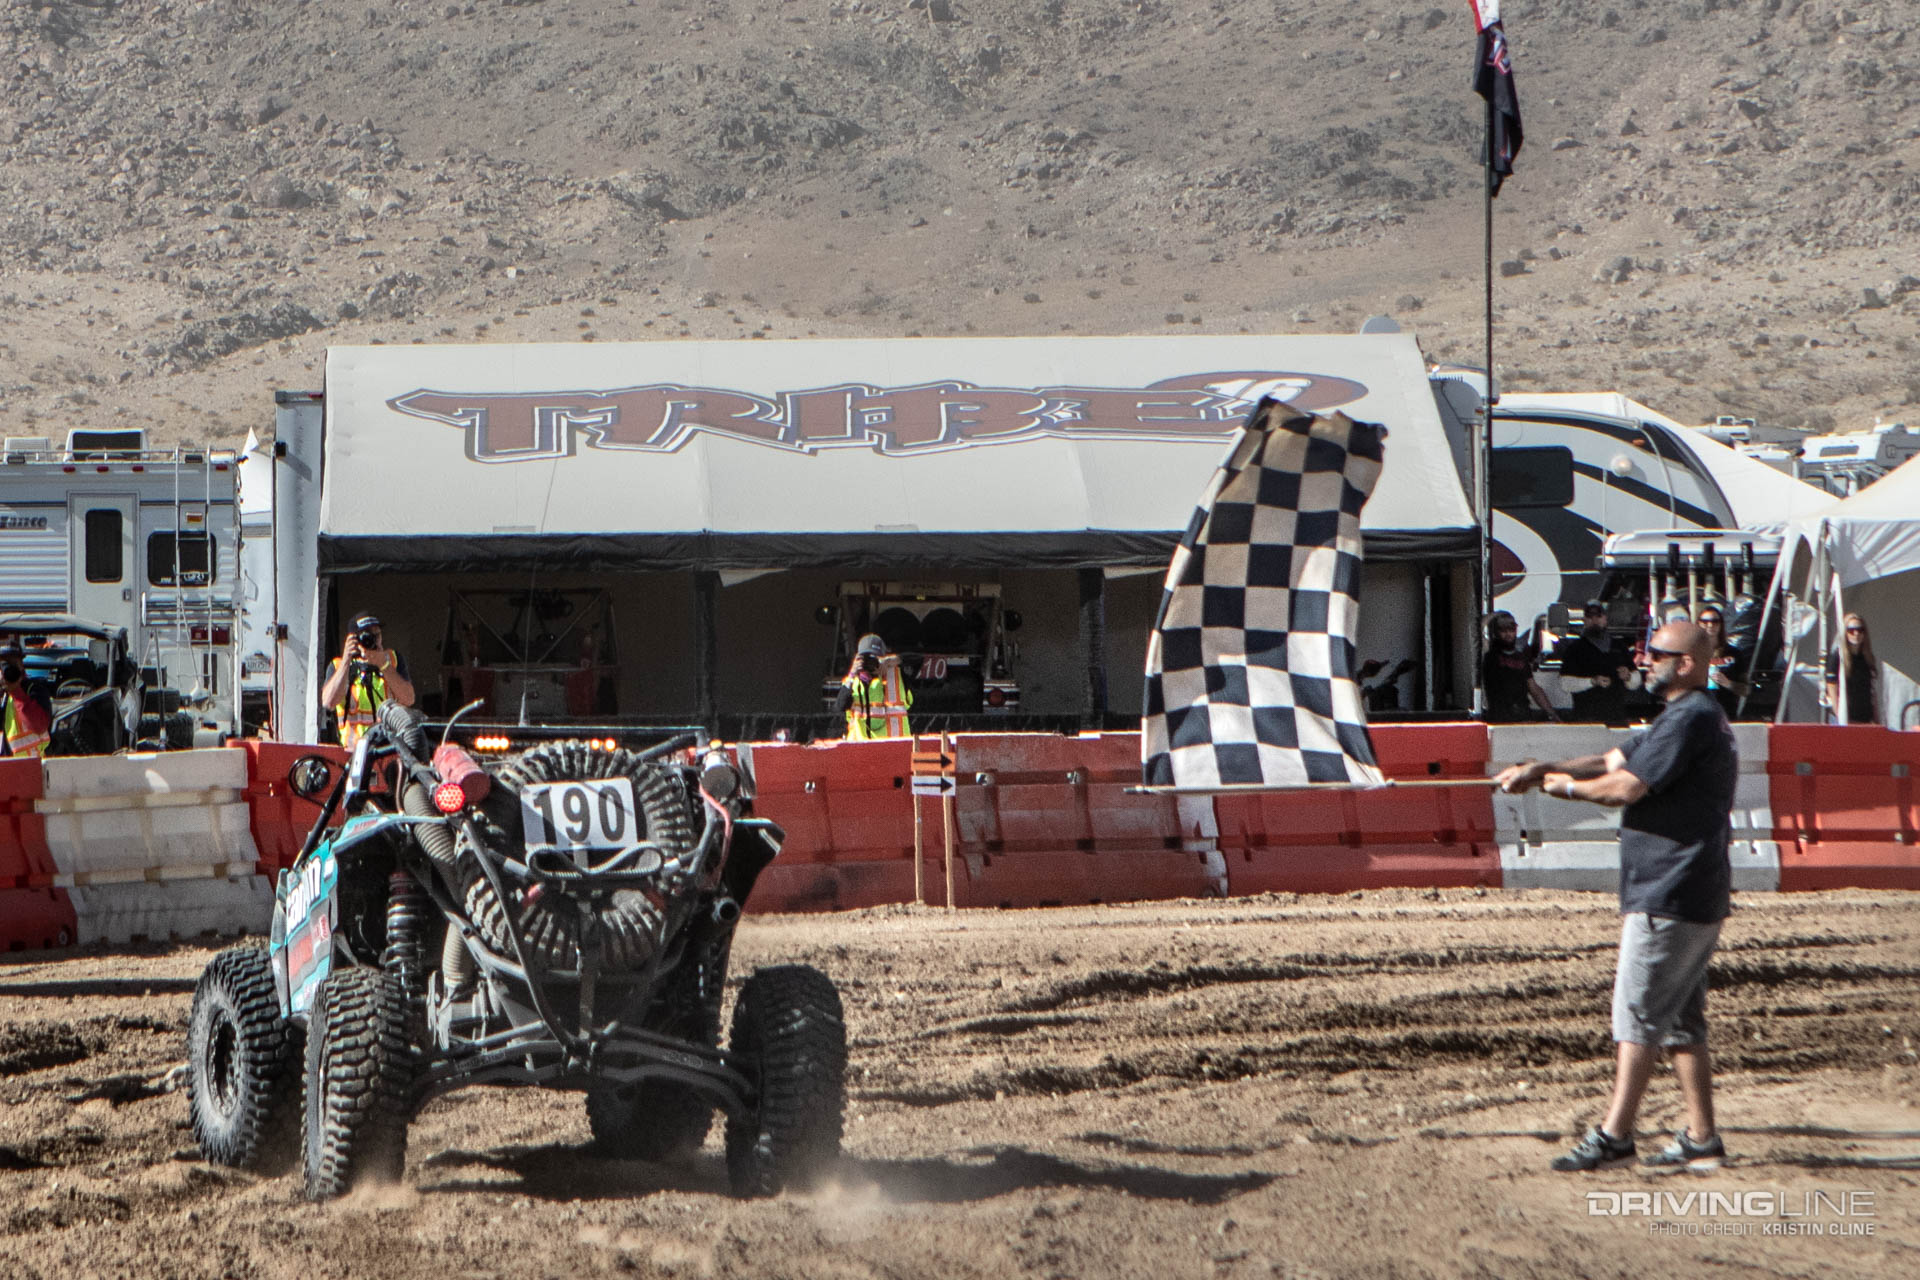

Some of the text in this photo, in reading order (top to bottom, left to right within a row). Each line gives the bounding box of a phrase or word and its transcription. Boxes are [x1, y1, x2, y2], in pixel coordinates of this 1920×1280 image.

[386, 381, 1248, 464] TRIBE
[915, 657, 947, 680] 10
[533, 786, 626, 846] 190
